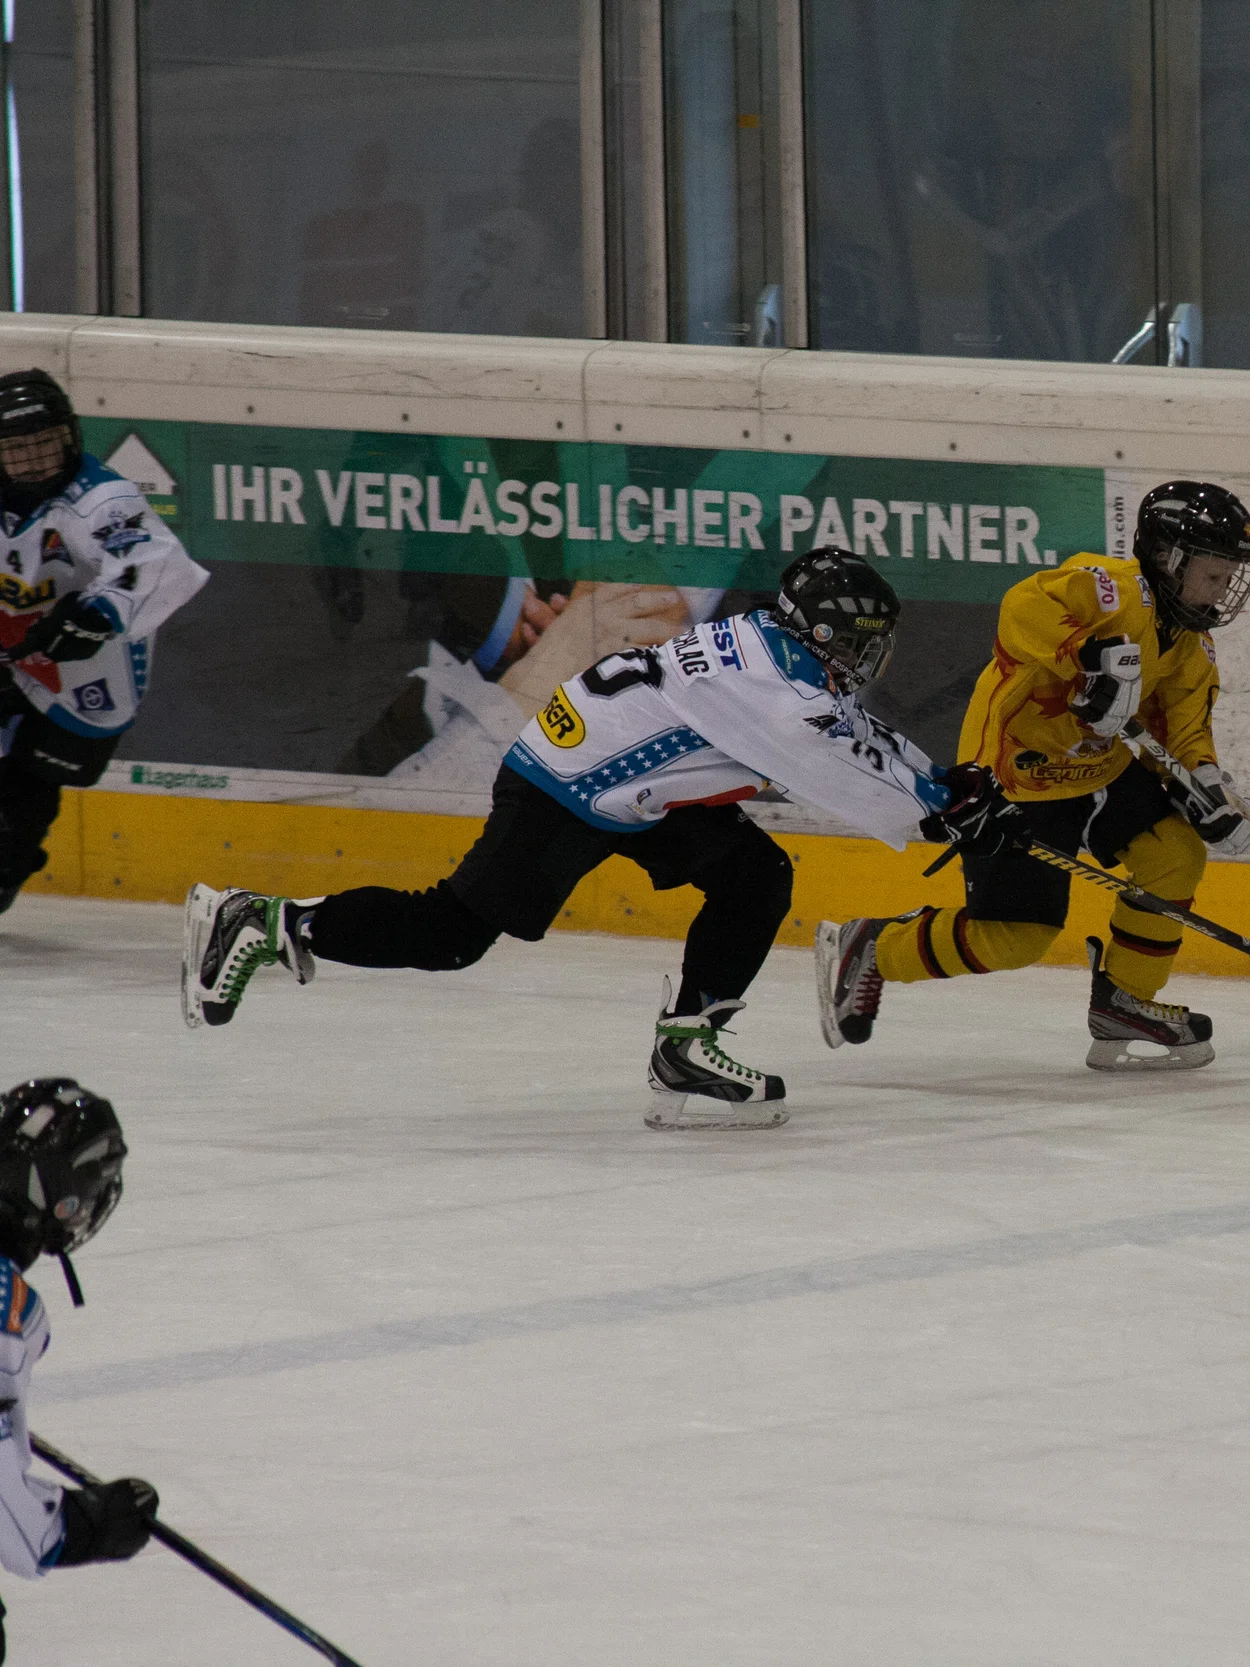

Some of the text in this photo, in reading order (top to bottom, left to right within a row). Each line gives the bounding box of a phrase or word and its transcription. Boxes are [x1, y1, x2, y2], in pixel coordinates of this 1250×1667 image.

[213, 461, 1057, 566] IHR VERLÄSSLICHER PARTNER.
